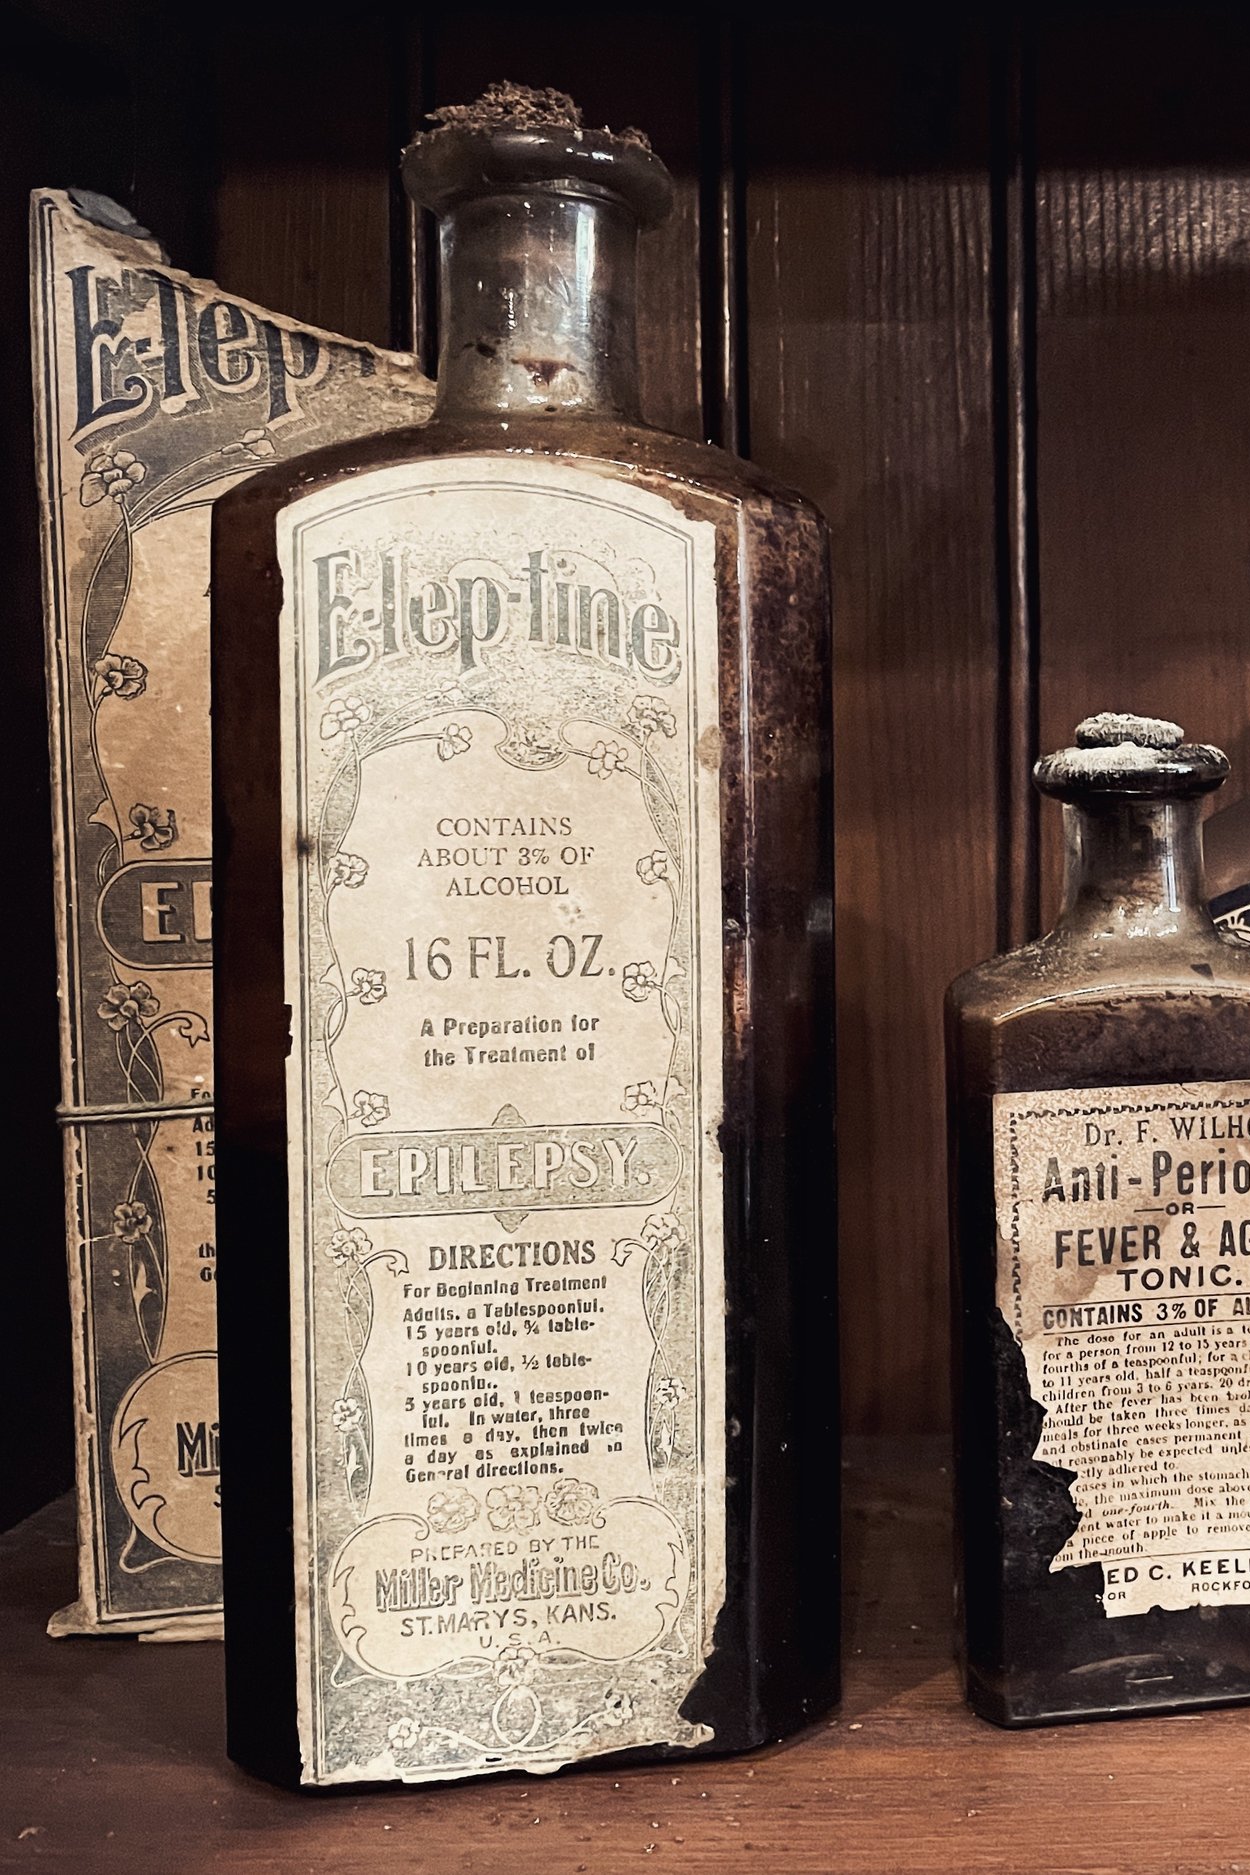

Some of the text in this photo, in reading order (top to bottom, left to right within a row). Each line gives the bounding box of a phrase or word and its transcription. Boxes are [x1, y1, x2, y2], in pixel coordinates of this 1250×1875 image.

[436, 817, 572, 837] CONTAINS
[418, 846, 595, 867] ABOUT 3% OF
[446, 875, 569, 896] ALCOHOL
[405, 934, 616, 981] 16 FL. OZ.
[420, 1014, 599, 1036] A Preparation for
[424, 1043, 596, 1066] the Treatment of
[1085, 1122, 1123, 1146] Dr.
[1136, 1119, 1157, 1143] F.
[360, 1137, 652, 1197] EPILEPSY.
[1165, 1202, 1195, 1216] OR
[428, 1240, 596, 1271] DIRECTIONS
[1055, 1225, 1161, 1269] FEVER
[1181, 1221, 1200, 1259] &
[403, 1275, 607, 1299] For Beginning Treatment
[1117, 1264, 1243, 1292] TONIC.
[1042, 1303, 1142, 1329] CONTAINS
[1156, 1303, 1187, 1321] 3%
[1194, 1298, 1218, 1318] OF
[406, 1325, 427, 1340] 15
[435, 1324, 480, 1341] years
[1056, 1336, 1080, 1347] The
[1087, 1334, 1115, 1344] dose
[1123, 1331, 1141, 1342] for
[1149, 1331, 1165, 1339] an
[1173, 1326, 1206, 1338] adult
[1211, 1325, 1222, 1336] is
[406, 1361, 427, 1376] 10
[434, 1360, 478, 1376] years
[476, 1461, 564, 1479] directions.
[529, 1539, 556, 1553] BY
[564, 1535, 600, 1551] THE
[376, 1552, 650, 1612] Miller Medicine Co.
[1149, 1565, 1171, 1581] C.
[546, 1602, 617, 1624] KANS.
[480, 1630, 561, 1649] U. S. A.
